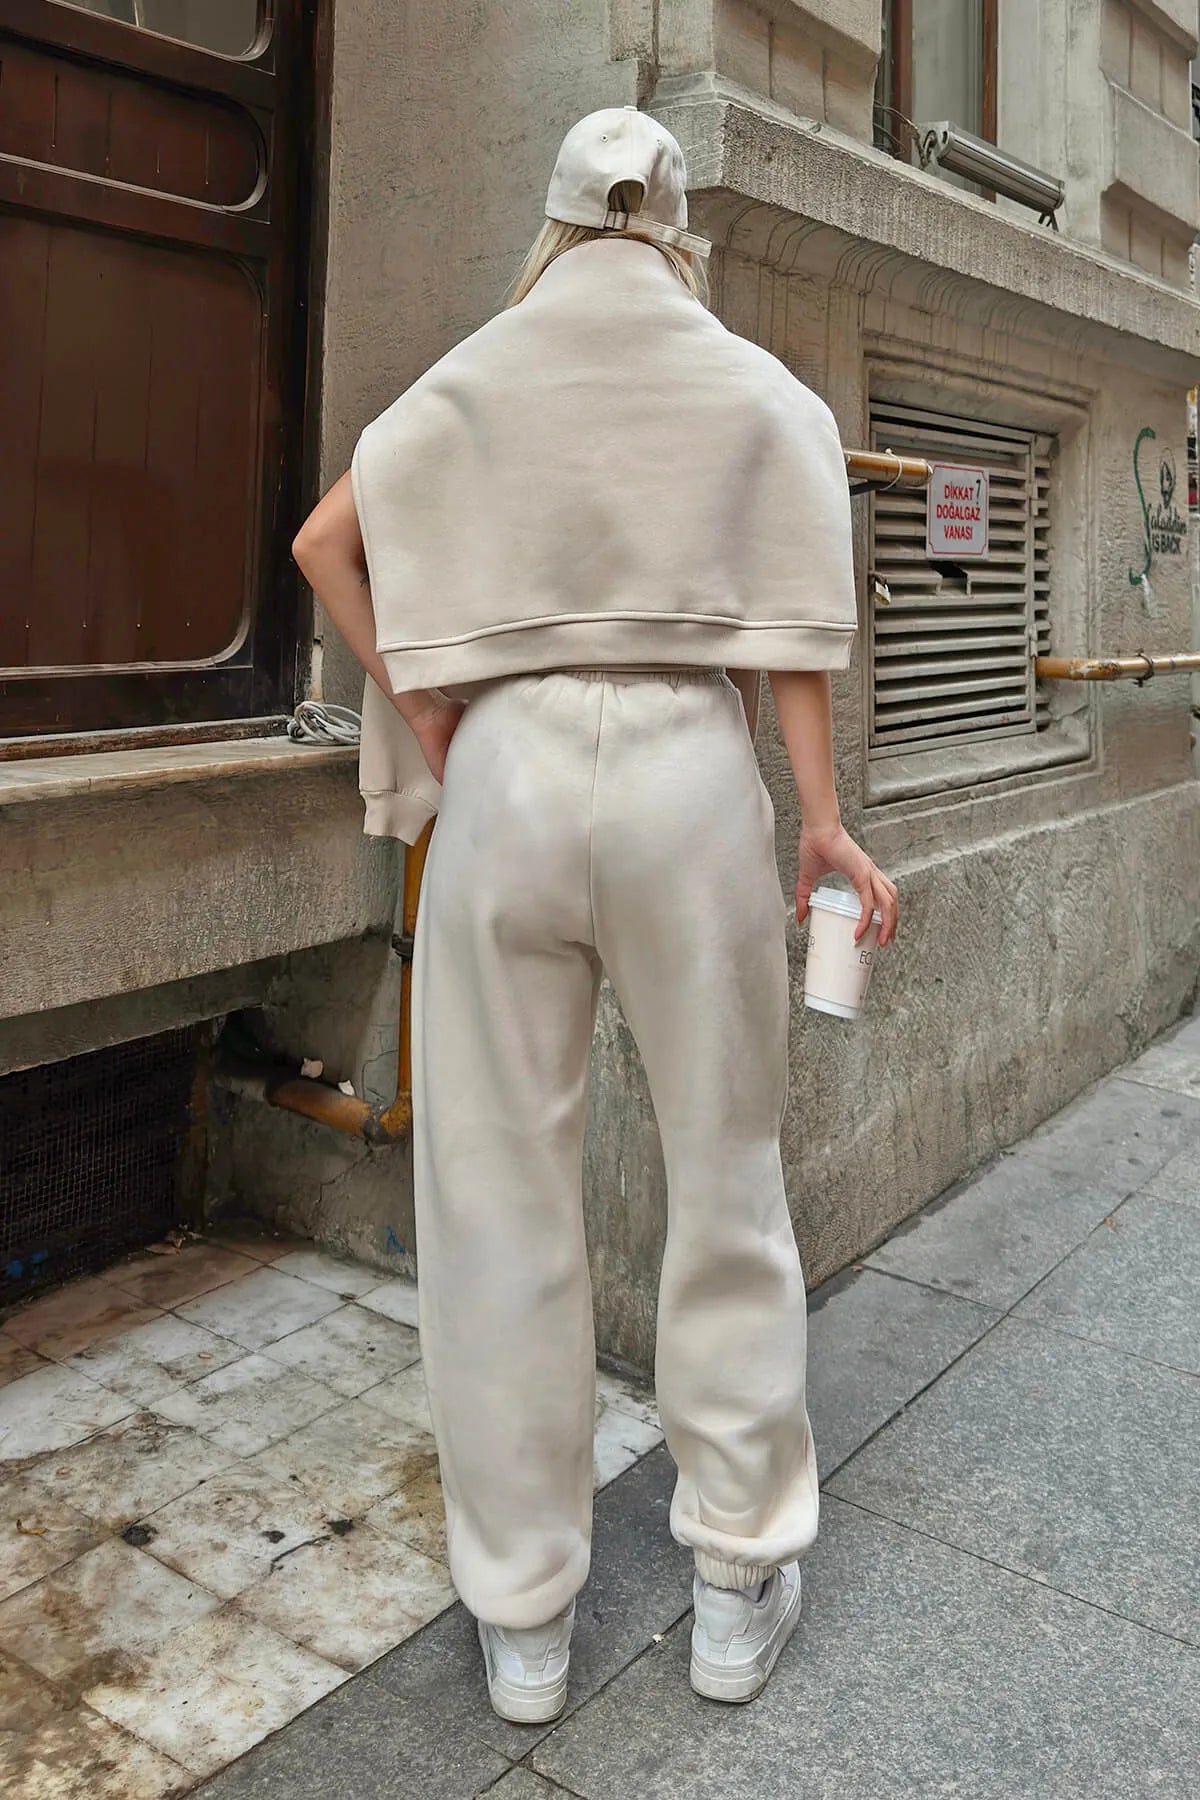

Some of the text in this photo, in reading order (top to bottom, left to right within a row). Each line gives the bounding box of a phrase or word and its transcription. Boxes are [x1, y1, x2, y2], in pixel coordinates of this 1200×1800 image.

[944, 481, 974, 501] DİKKAT
[936, 502, 981, 521] DOĞALGAZ
[943, 525, 973, 540] VANASI
